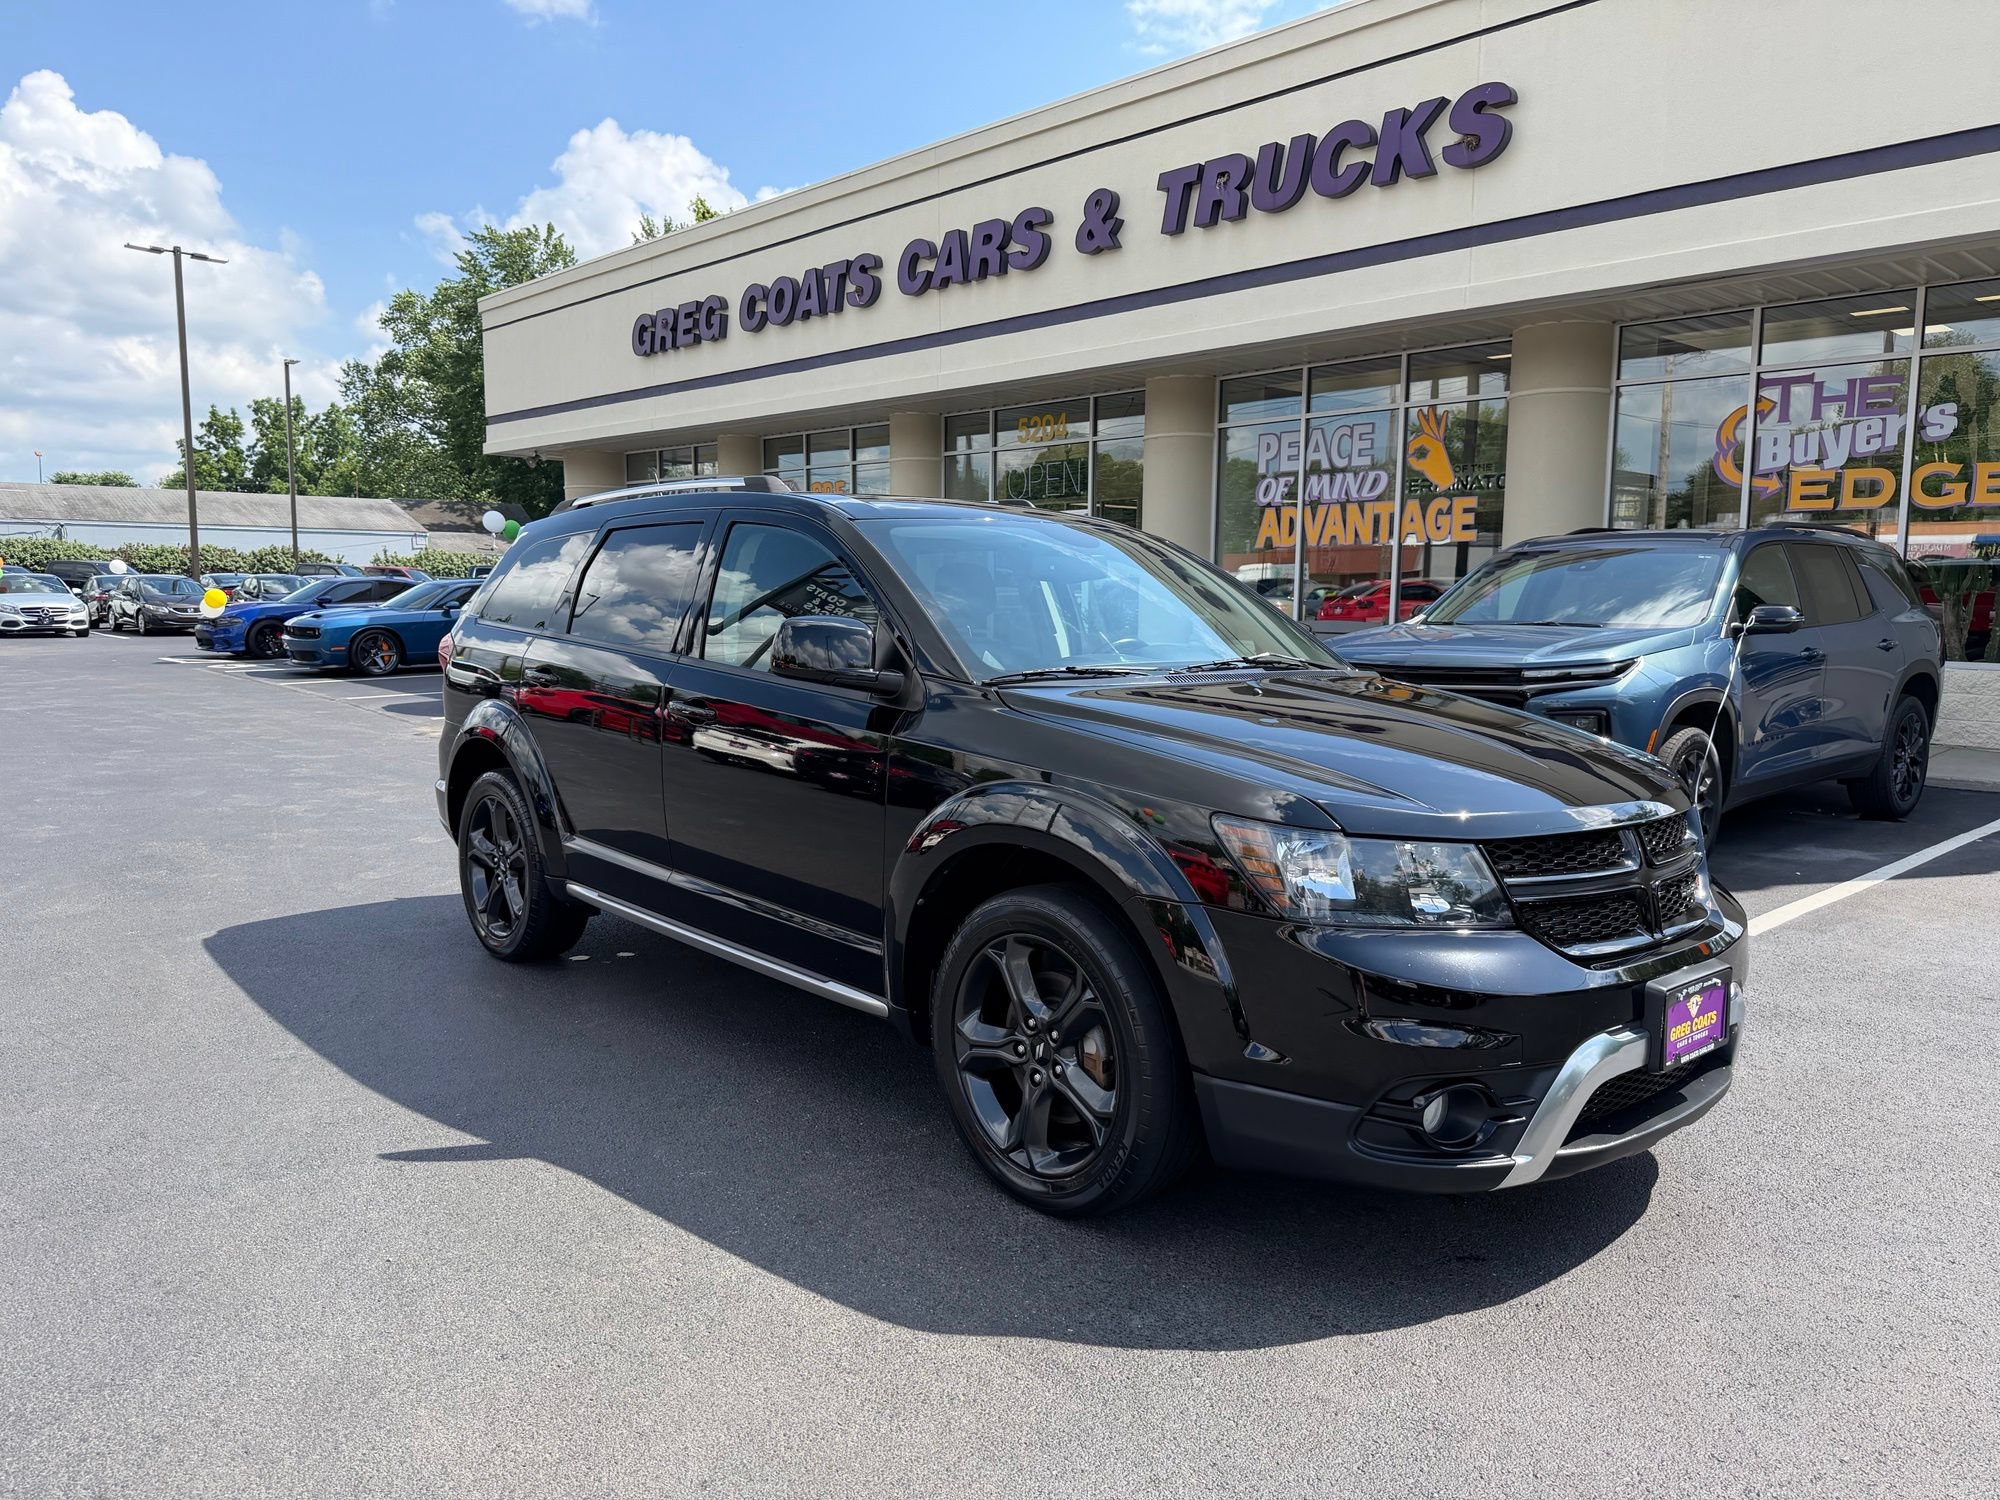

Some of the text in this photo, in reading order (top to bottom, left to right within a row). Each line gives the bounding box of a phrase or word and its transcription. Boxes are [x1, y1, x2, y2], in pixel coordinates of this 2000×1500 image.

[632, 82, 1518, 357] GREG COATS CARS & TRUCKS
[1758, 372, 1905, 424] THE
[1017, 411, 1069, 443] 5204
[1257, 421, 1376, 475] PEACE
[1007, 460, 1081, 500] OPEN
[1255, 469, 1390, 507] OF MIND
[1785, 461, 2000, 513] EDGE
[1255, 495, 1478, 549] ADVANTAGE
[1670, 1010, 1718, 1041] GREG COATS
